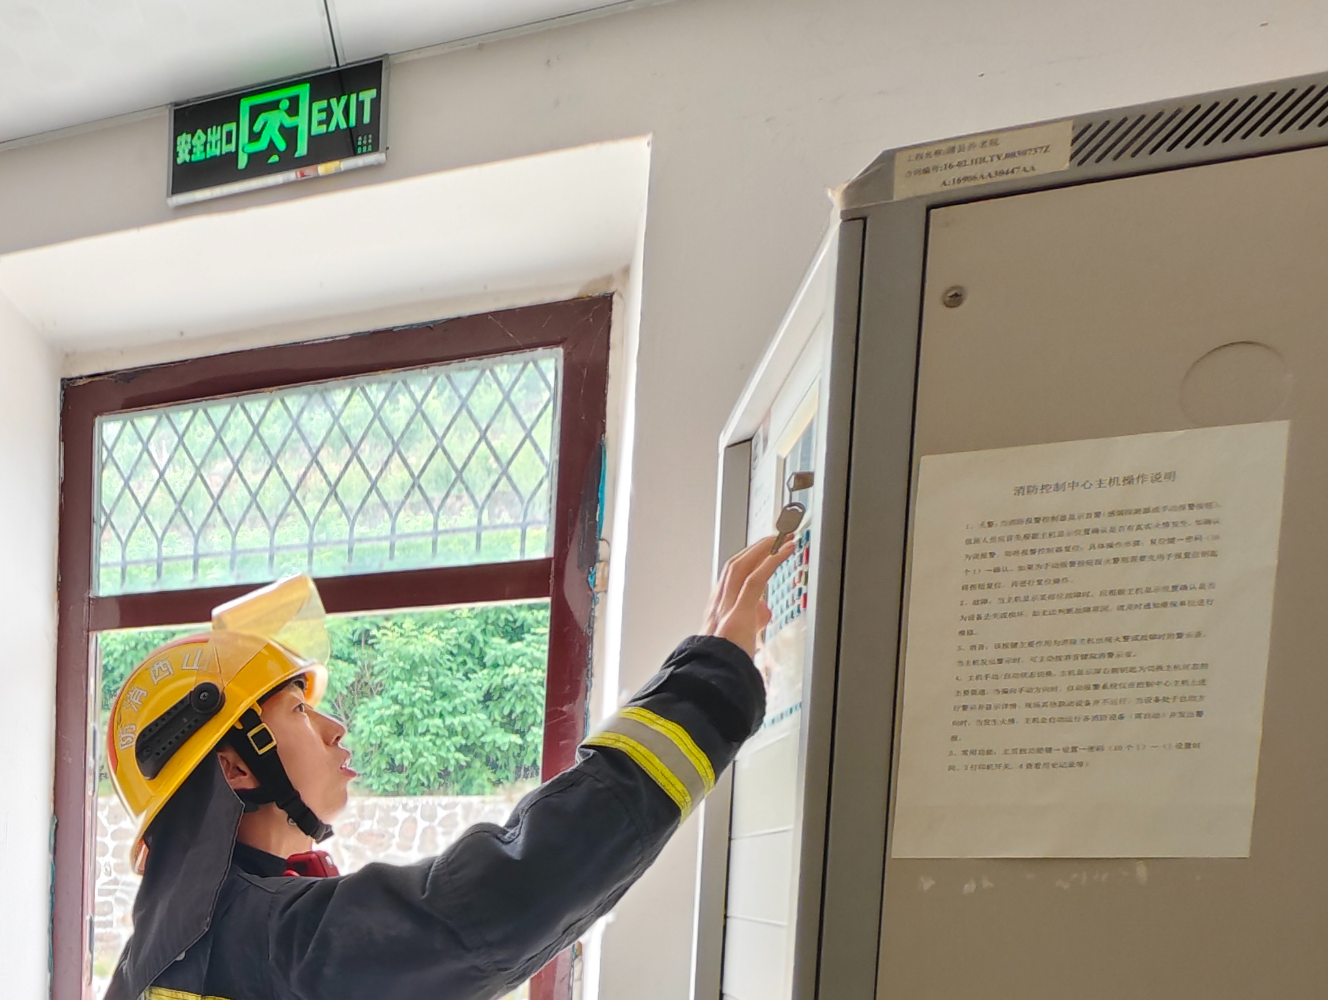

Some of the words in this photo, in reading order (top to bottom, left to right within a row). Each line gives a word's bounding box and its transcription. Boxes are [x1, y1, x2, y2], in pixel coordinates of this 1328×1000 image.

[176, 122, 237, 165] 安全出口
[311, 88, 377, 136] EXIT
[1011, 468, 1178, 498] 消防控制中心主机操作说明
